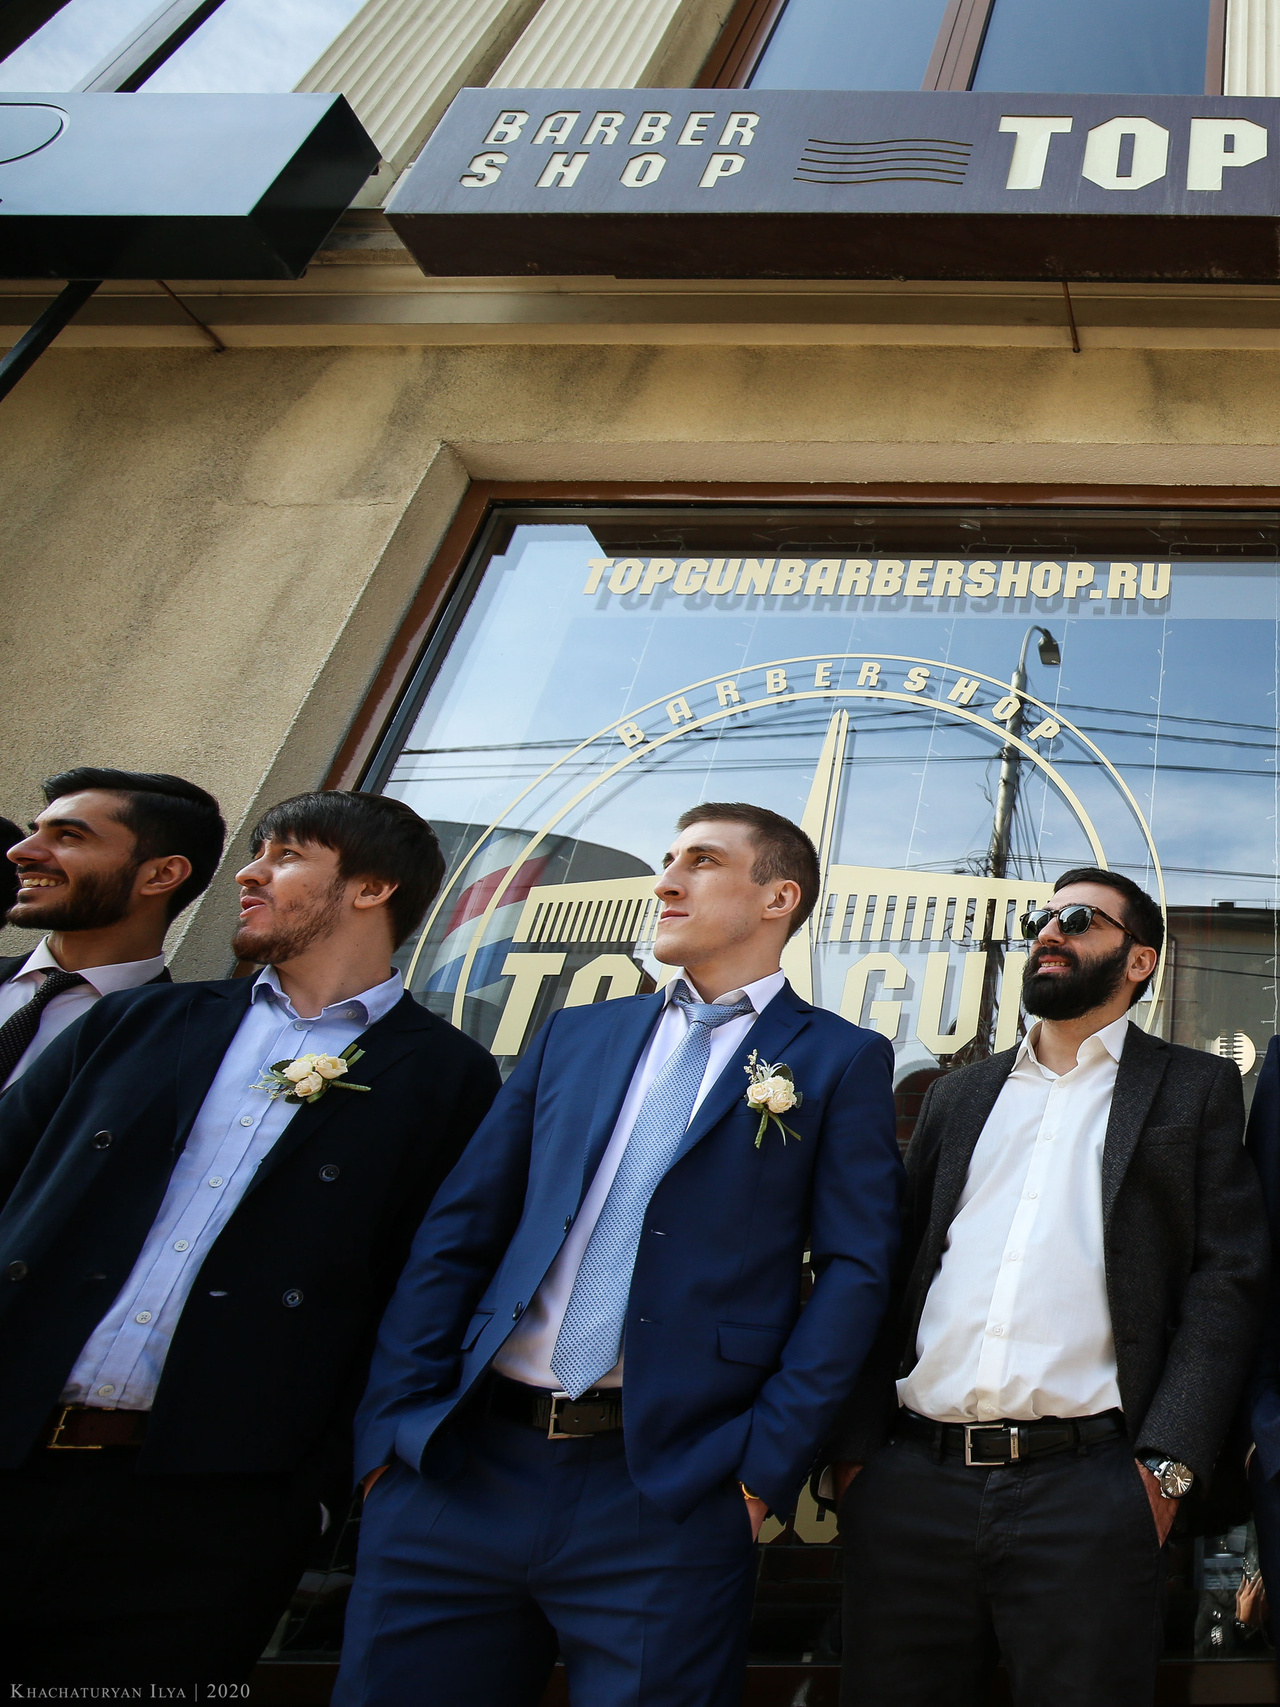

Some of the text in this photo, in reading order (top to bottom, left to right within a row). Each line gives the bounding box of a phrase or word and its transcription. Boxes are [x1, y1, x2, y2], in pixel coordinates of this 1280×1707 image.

[482, 109, 760, 146] BARBER
[459, 151, 746, 188] SHOP
[583, 558, 1171, 600] TOPGUNBARBERSHOP.RU
[616, 661, 1061, 749] BARBERSHOP
